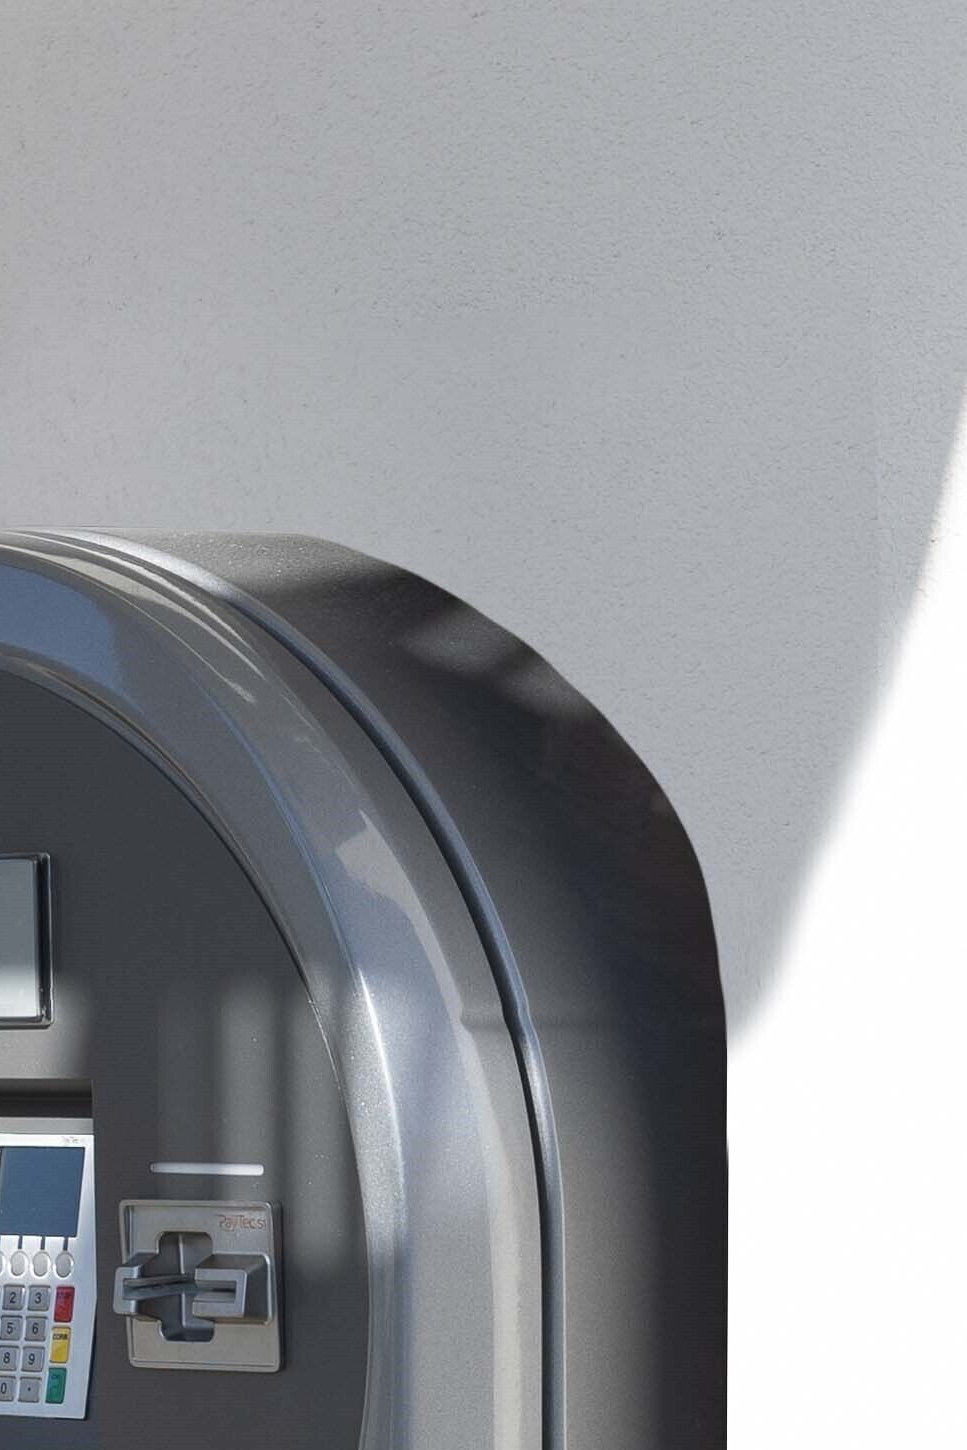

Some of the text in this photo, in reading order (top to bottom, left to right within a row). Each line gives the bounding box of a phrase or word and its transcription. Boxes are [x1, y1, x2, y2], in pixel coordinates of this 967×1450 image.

[9, 1291, 17, 1304] 2
[34, 1292, 43, 1304] 3
[6, 1322, 14, 1334] 5
[32, 1322, 40, 1335] 6
[2, 1351, 11, 1364] 8
[27, 1353, 36, 1365] 9
[0, 1382, 8, 1394] 0
